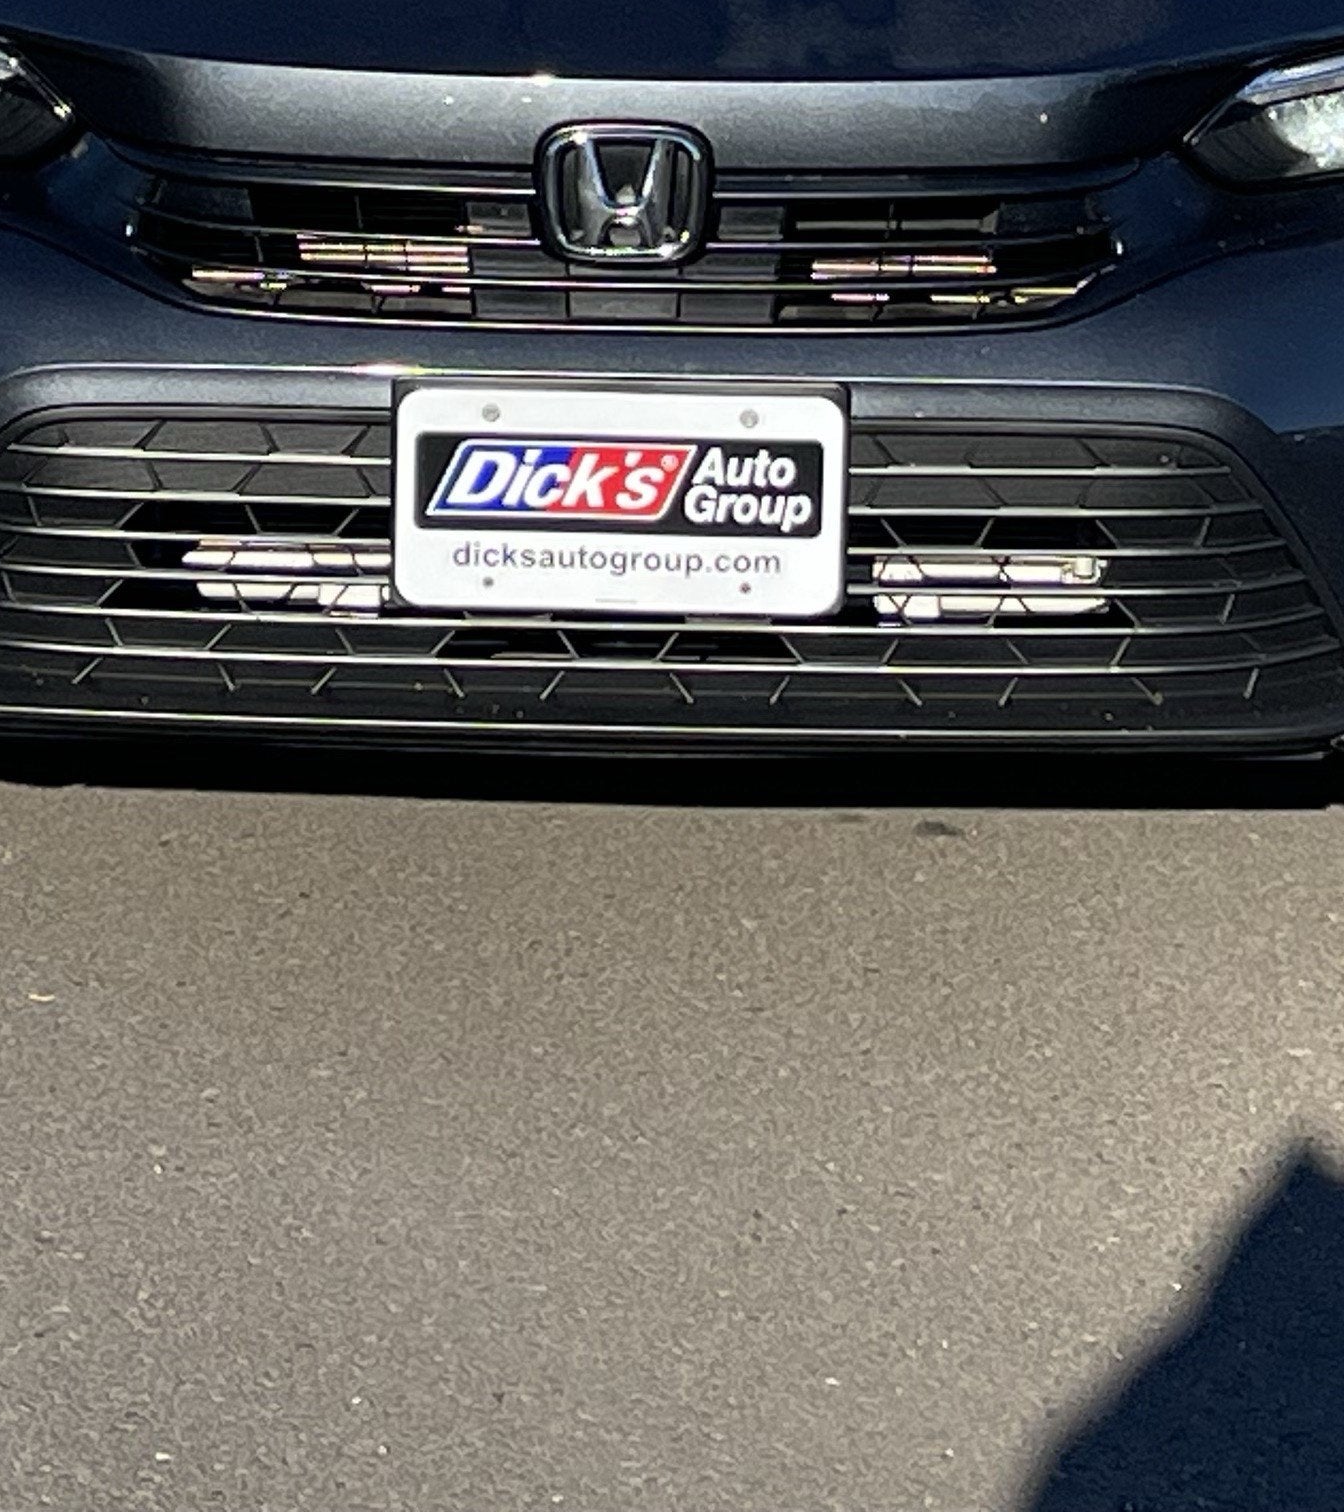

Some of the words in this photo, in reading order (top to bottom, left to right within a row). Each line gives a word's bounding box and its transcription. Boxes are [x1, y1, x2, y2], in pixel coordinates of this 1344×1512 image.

[446, 449, 664, 510] Dick's
[692, 447, 796, 488] Auto
[684, 485, 812, 532] Group
[452, 542, 781, 576] dicksautogroup.com
